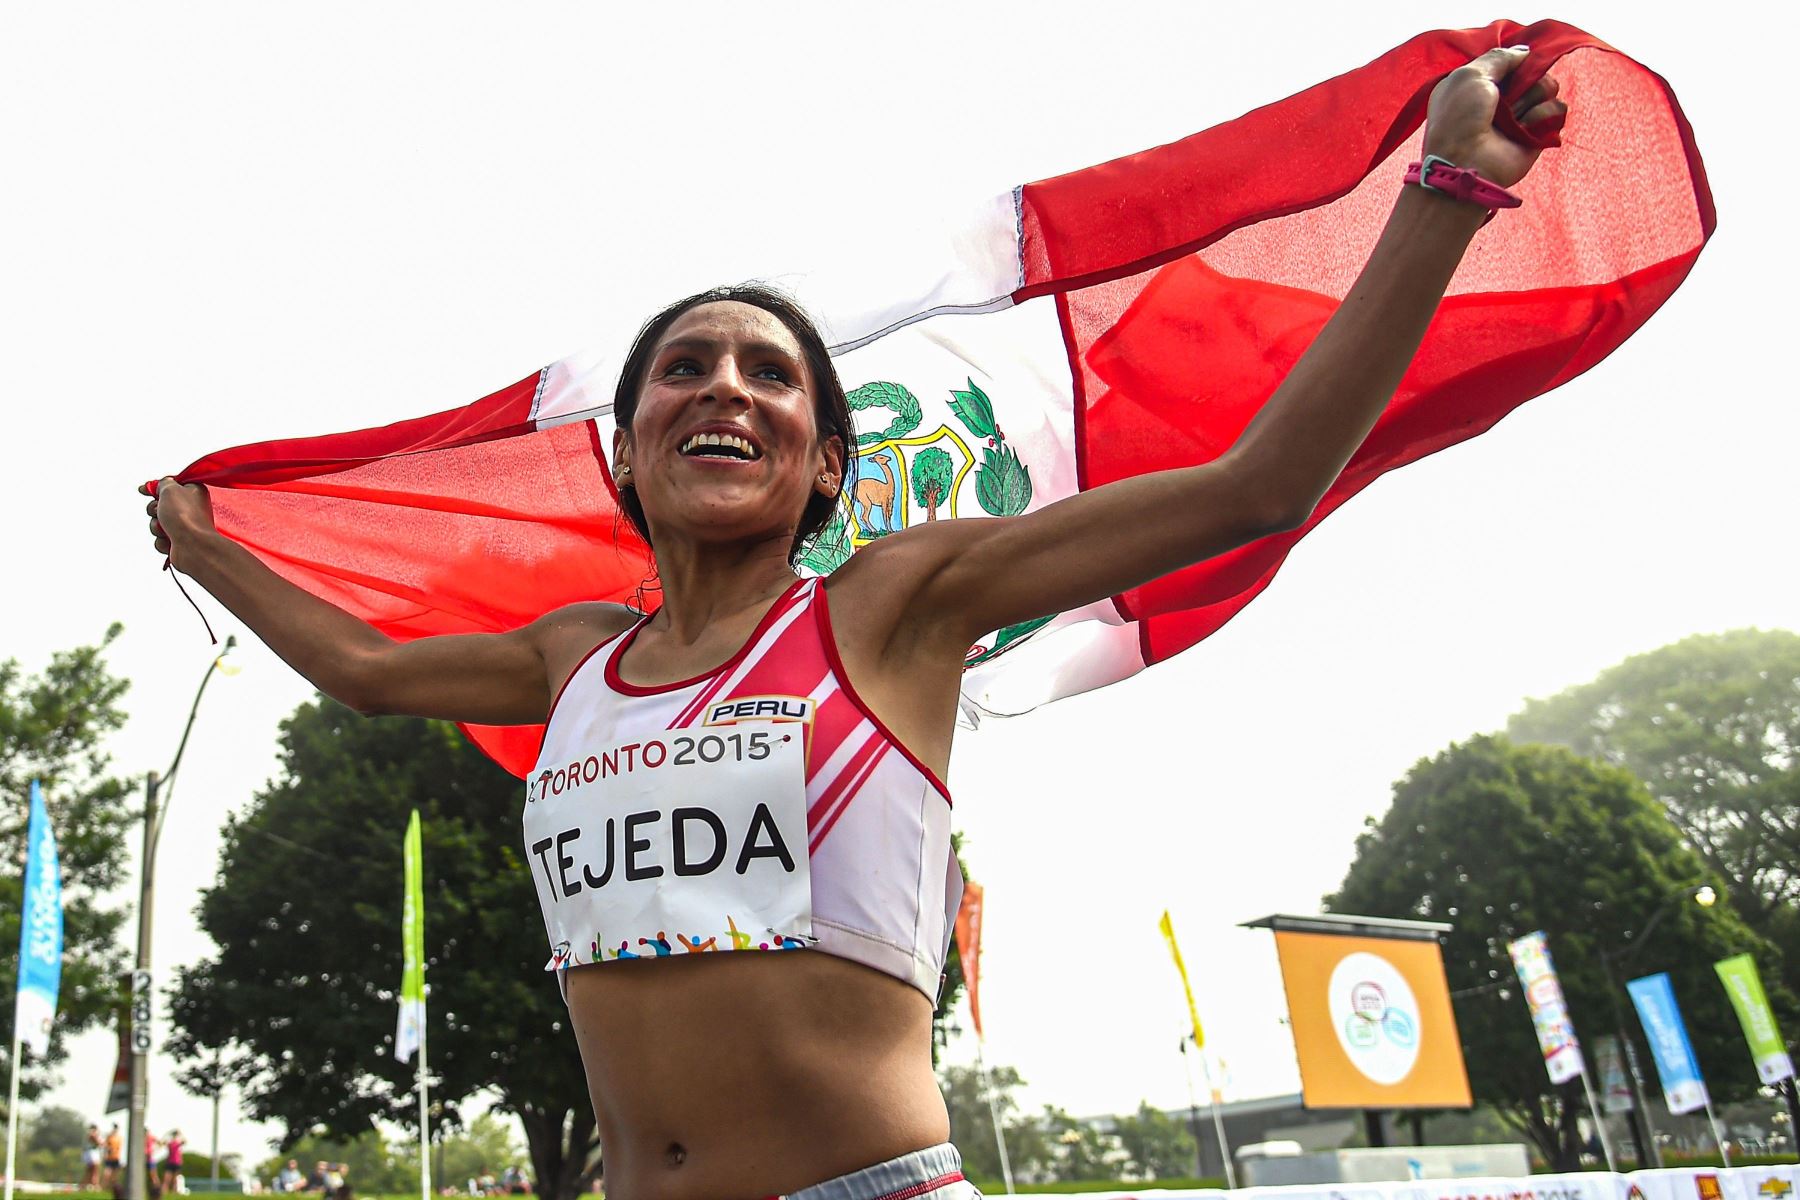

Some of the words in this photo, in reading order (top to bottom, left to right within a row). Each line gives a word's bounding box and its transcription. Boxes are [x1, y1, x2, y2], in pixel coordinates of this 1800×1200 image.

[711, 700, 807, 722] PERU
[540, 740, 667, 800] TORONTO
[673, 732, 771, 766] 2015
[531, 803, 796, 904] TEJEDA
[135, 972, 152, 1049] 286
